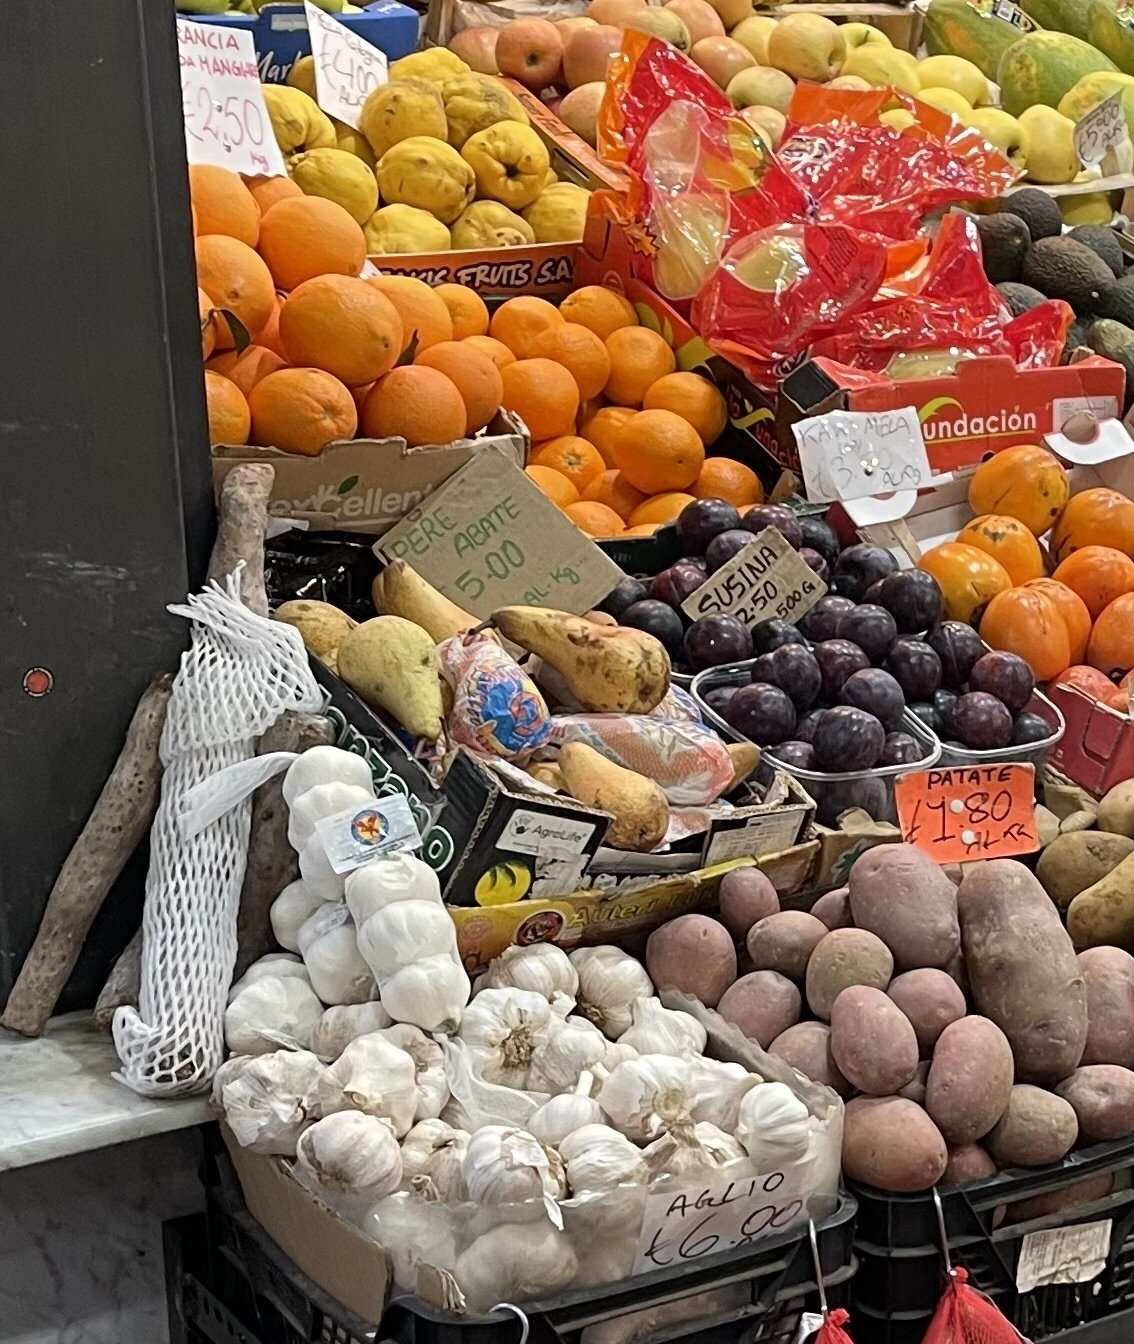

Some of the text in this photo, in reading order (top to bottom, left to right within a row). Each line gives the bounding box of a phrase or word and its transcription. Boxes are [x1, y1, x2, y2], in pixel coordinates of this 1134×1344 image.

[457, 262, 532, 287] FRUITS
[389, 506, 458, 560] PERE
[453, 496, 522, 558] ABATE
[698, 546, 779, 613] SUSINA
[927, 765, 1014, 790] PATATE
[666, 1172, 785, 1218] AGLIO
